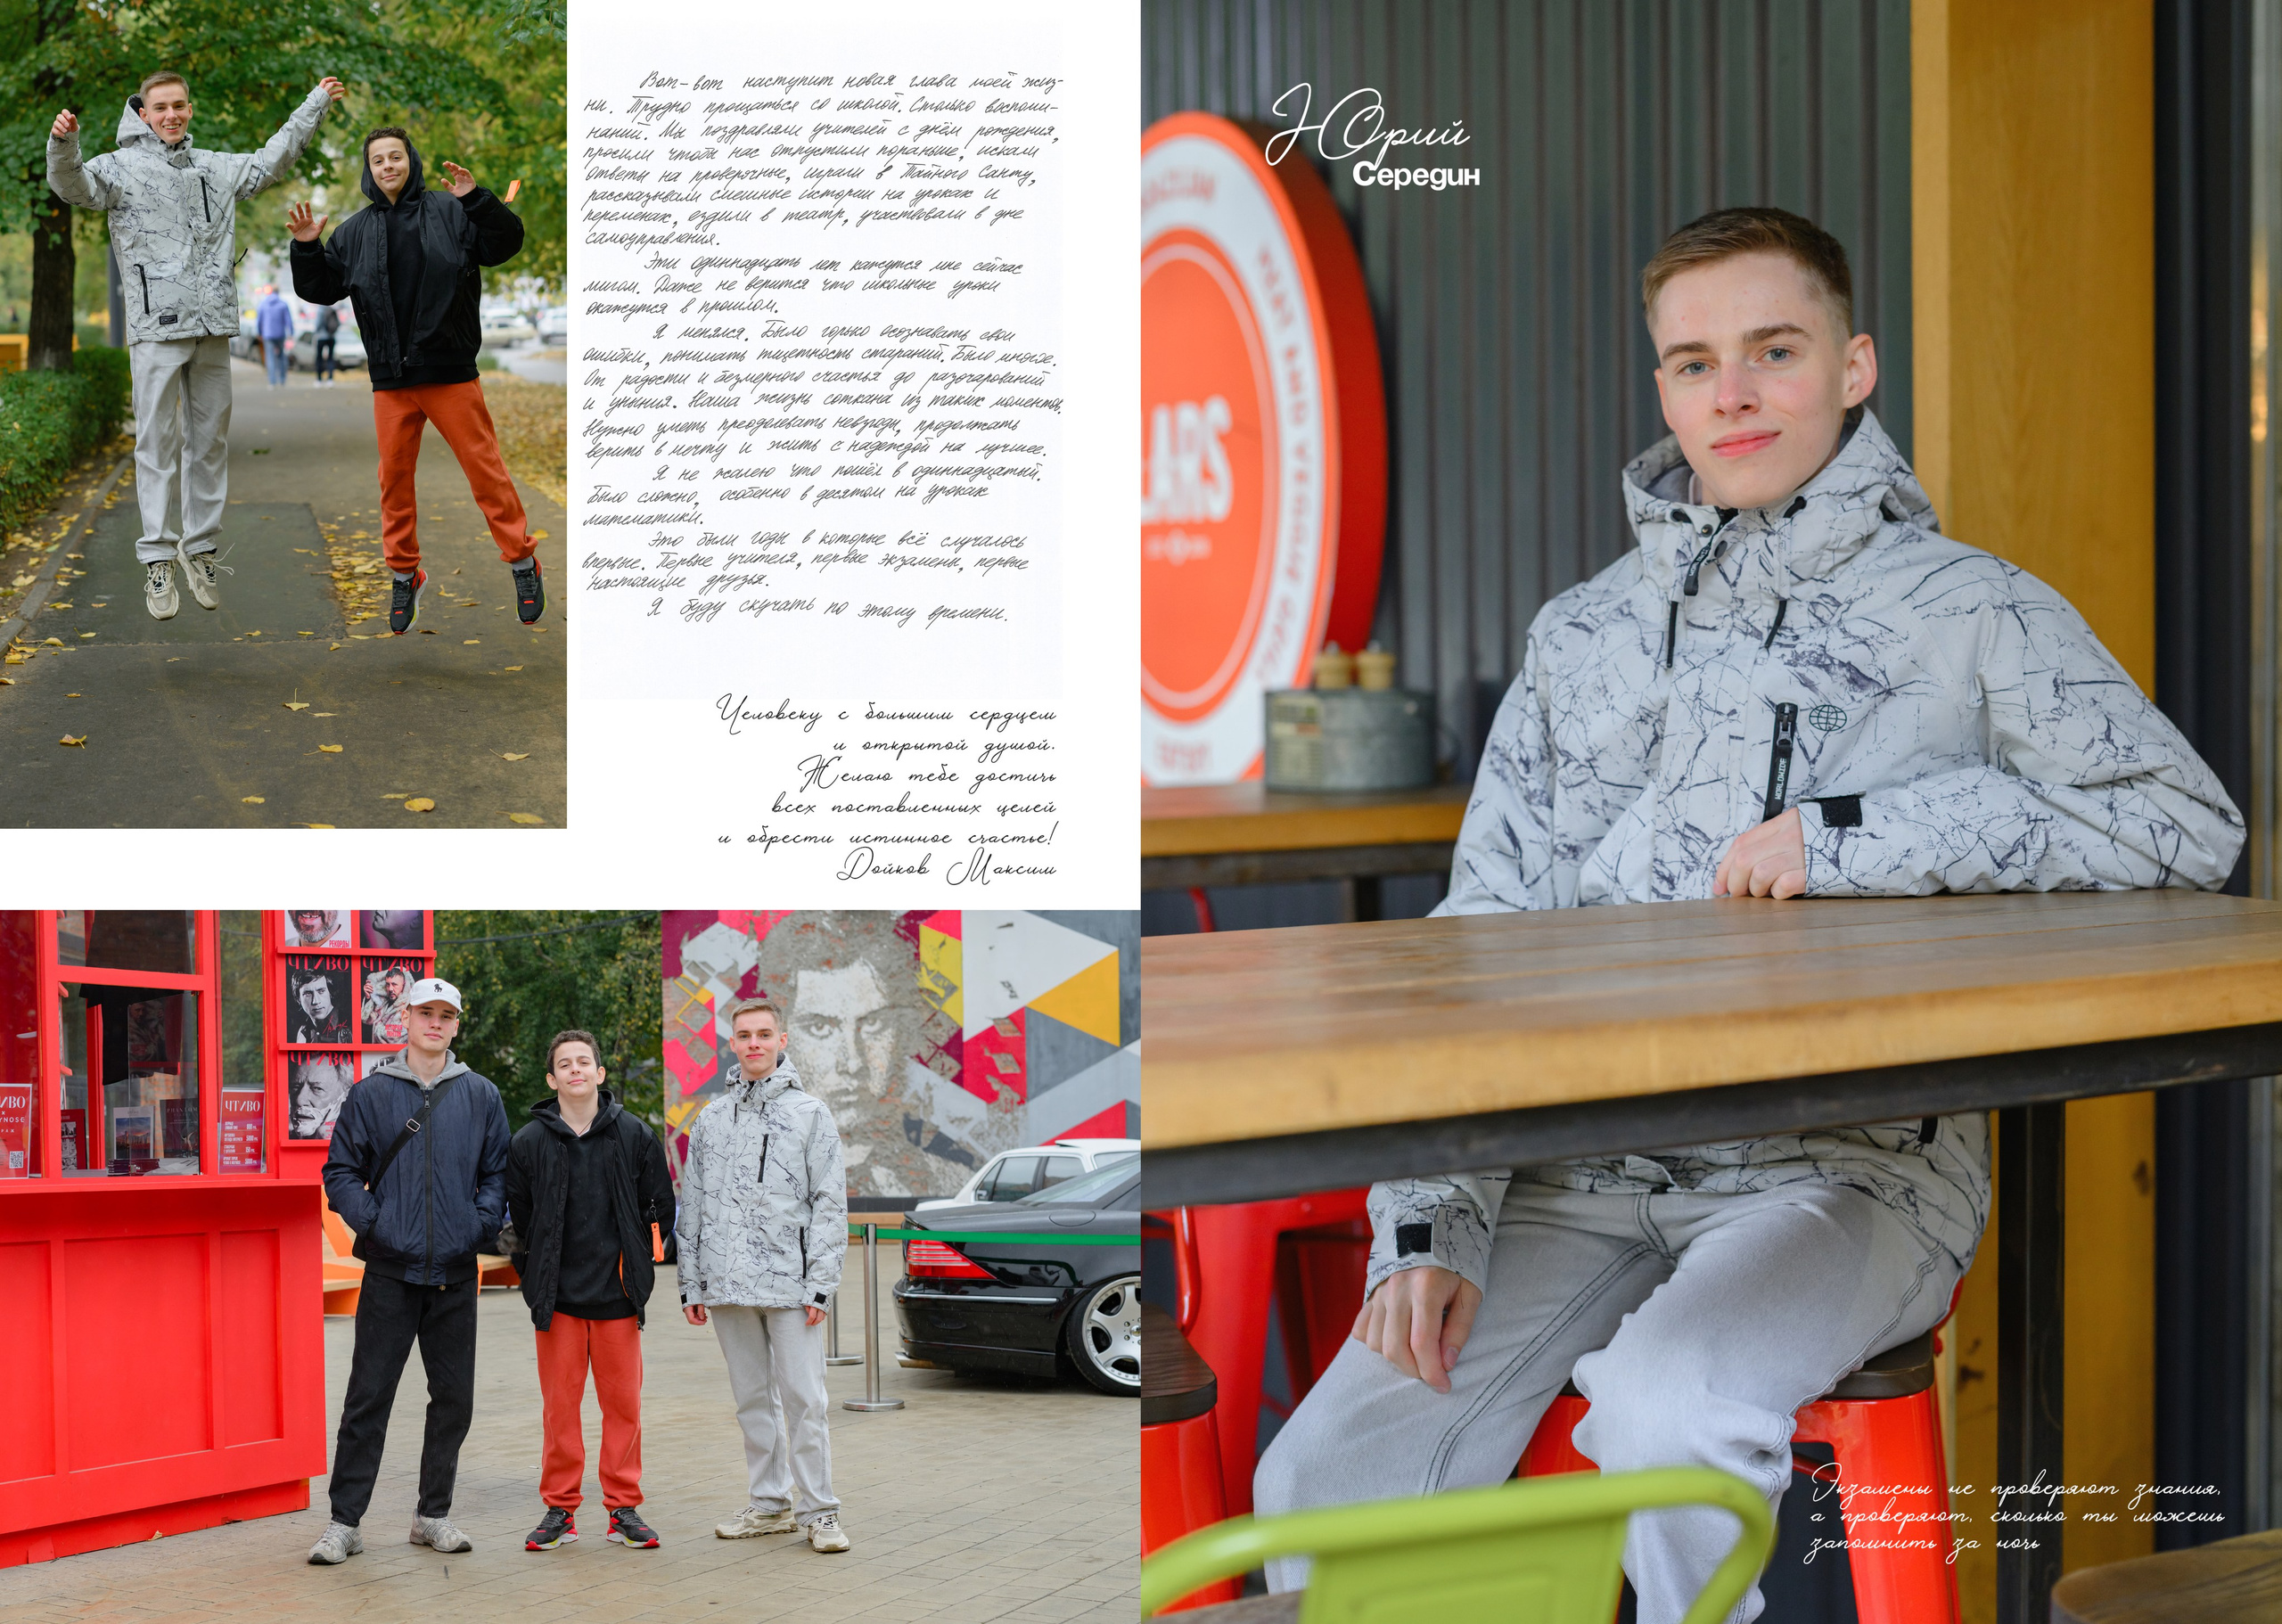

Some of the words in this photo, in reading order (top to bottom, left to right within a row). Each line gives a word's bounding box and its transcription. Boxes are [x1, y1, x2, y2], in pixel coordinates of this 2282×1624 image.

[640, 71, 723, 90] Вот-вот
[743, 76, 833, 94] наступит
[842, 73, 896, 88] новая
[909, 74, 957, 87] глава
[969, 71, 1017, 88] моей
[1022, 78, 1063, 94] жиз-
[584, 100, 612, 113] ни.
[627, 96, 691, 123] Трудно
[703, 99, 799, 123] прощаться
[811, 98, 831, 110] со
[837, 93, 904, 112] школой.
[909, 96, 975, 112] Столько
[985, 98, 1058, 113] воспоми-
[587, 122, 651, 140] наний.
[659, 119, 686, 139] Мы
[701, 124, 802, 144] поздравляли
[809, 119, 891, 143] учителей
[898, 126, 909, 135] с
[914, 122, 962, 142] днём
[965, 127, 1058, 149] рождения,
[583, 147, 654, 169] просили
[669, 148, 718, 161] чтобы
[728, 147, 759, 159] нас
[771, 144, 869, 164] отпустили
[876, 145, 964, 167] пораньше,
[977, 146, 1039, 158] искали
[581, 190, 702, 210] рассказывали
[710, 189, 791, 201] смешные
[799, 189, 874, 208] истории
[881, 189, 905, 200] на
[909, 189, 973, 207] уроках
[984, 188, 999, 199] и
[583, 209, 677, 232] переменах,
[688, 210, 751, 233] ездили
[759, 208, 776, 221] в
[782, 209, 848, 230] театр,
[856, 208, 966, 227] участвовали
[974, 206, 990, 219] в
[990, 210, 1023, 226] дне
[586, 232, 719, 254] самоуправления.
[644, 251, 681, 269] Эти
[691, 257, 801, 277] одиннадцать
[809, 259, 841, 271] лет
[850, 260, 922, 278] кажутся
[930, 261, 962, 271] мне
[973, 257, 1022, 274] сейчас
[583, 281, 639, 294] мигом.
[653, 275, 702, 293] Даже
[716, 281, 737, 291] не
[745, 276, 809, 300] верится
[822, 279, 854, 291] что
[862, 279, 936, 291] школьные
[948, 281, 1000, 299] уроки
[586, 302, 668, 322] окажутся
[680, 298, 696, 313] в
[698, 299, 777, 322] прошлом.
[653, 324, 669, 339] Я
[677, 327, 748, 341] менялся.
[761, 320, 808, 338] Было
[822, 326, 870, 345] горько
[880, 324, 971, 348] осознавать
[980, 329, 1015, 341] свои
[584, 369, 605, 387] От
[612, 373, 690, 396] радости
[698, 373, 709, 384] и
[714, 371, 805, 394] безмерного
[812, 371, 882, 381] счастья
[890, 372, 915, 390] до
[918, 371, 1050, 394] разочарований
[583, 419, 644, 445] Нужно
[653, 422, 707, 443] уметь
[718, 416, 826, 441] преодолевать
[833, 415, 901, 437] невзгоды,
[914, 420, 1020, 440] продолжать
[653, 465, 669, 480] Я
[678, 469, 700, 480] не
[713, 467, 776, 480] жалею
[790, 463, 821, 477] что
[832, 463, 882, 477] пошёл
[892, 462, 908, 478] в
[912, 463, 1042, 485] одиннадцатый.
[583, 511, 702, 526] математики.
[649, 531, 684, 547] Это
[697, 532, 739, 545] были
[751, 531, 790, 551] годы
[802, 529, 816, 543] в
[818, 532, 886, 553] которые
[898, 530, 929, 545] всё
[941, 536, 1027, 554] случалось
[587, 577, 685, 591] настоящие
[699, 574, 768, 595] друзья.
[647, 597, 663, 616] Я
[680, 599, 726, 622] буду
[739, 598, 816, 618] скучать
[824, 602, 849, 615] по
[858, 604, 916, 627] этому
[925, 605, 1007, 629] времени.
[1774, 758, 1787, 800] WORLDWIDE
